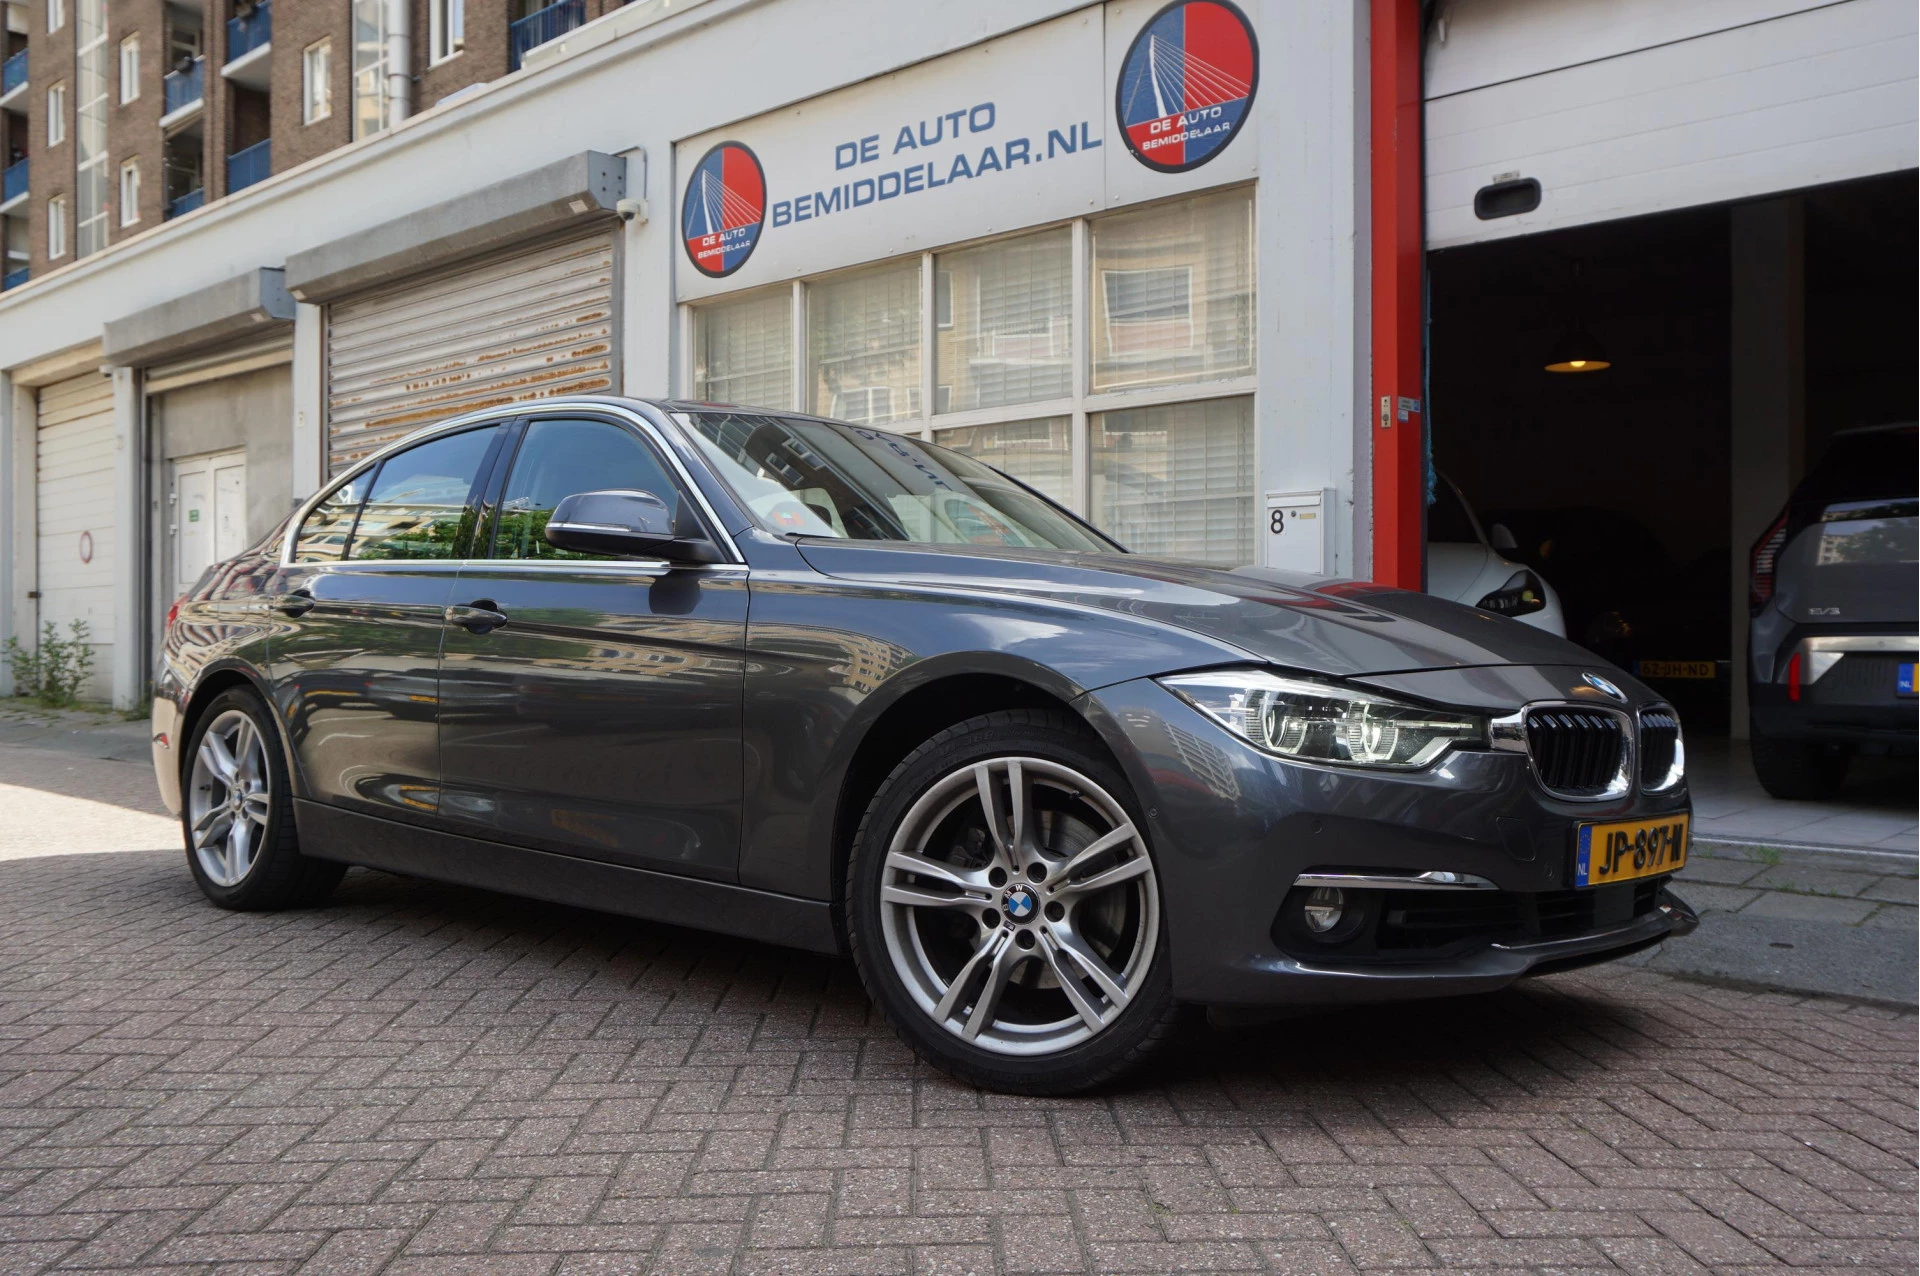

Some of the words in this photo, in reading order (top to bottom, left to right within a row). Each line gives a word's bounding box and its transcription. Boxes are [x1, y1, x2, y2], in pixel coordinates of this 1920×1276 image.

[1149, 119, 1172, 135] DE
[1176, 106, 1222, 128] AUTO
[835, 135, 880, 170] DE
[894, 102, 996, 153] AUTO
[1142, 122, 1230, 151] BEMIDDELAAR
[773, 122, 1103, 228] BEMIDDELAAR.NL
[697, 240, 751, 259] BEMIDDELAAR
[702, 235, 716, 247] DE
[719, 228, 746, 242] AUTO
[1270, 509, 1285, 535] 8
[1899, 680, 1912, 688] NL
[1598, 823, 1683, 874] JP-897-N
[1577, 862, 1588, 877] NL
